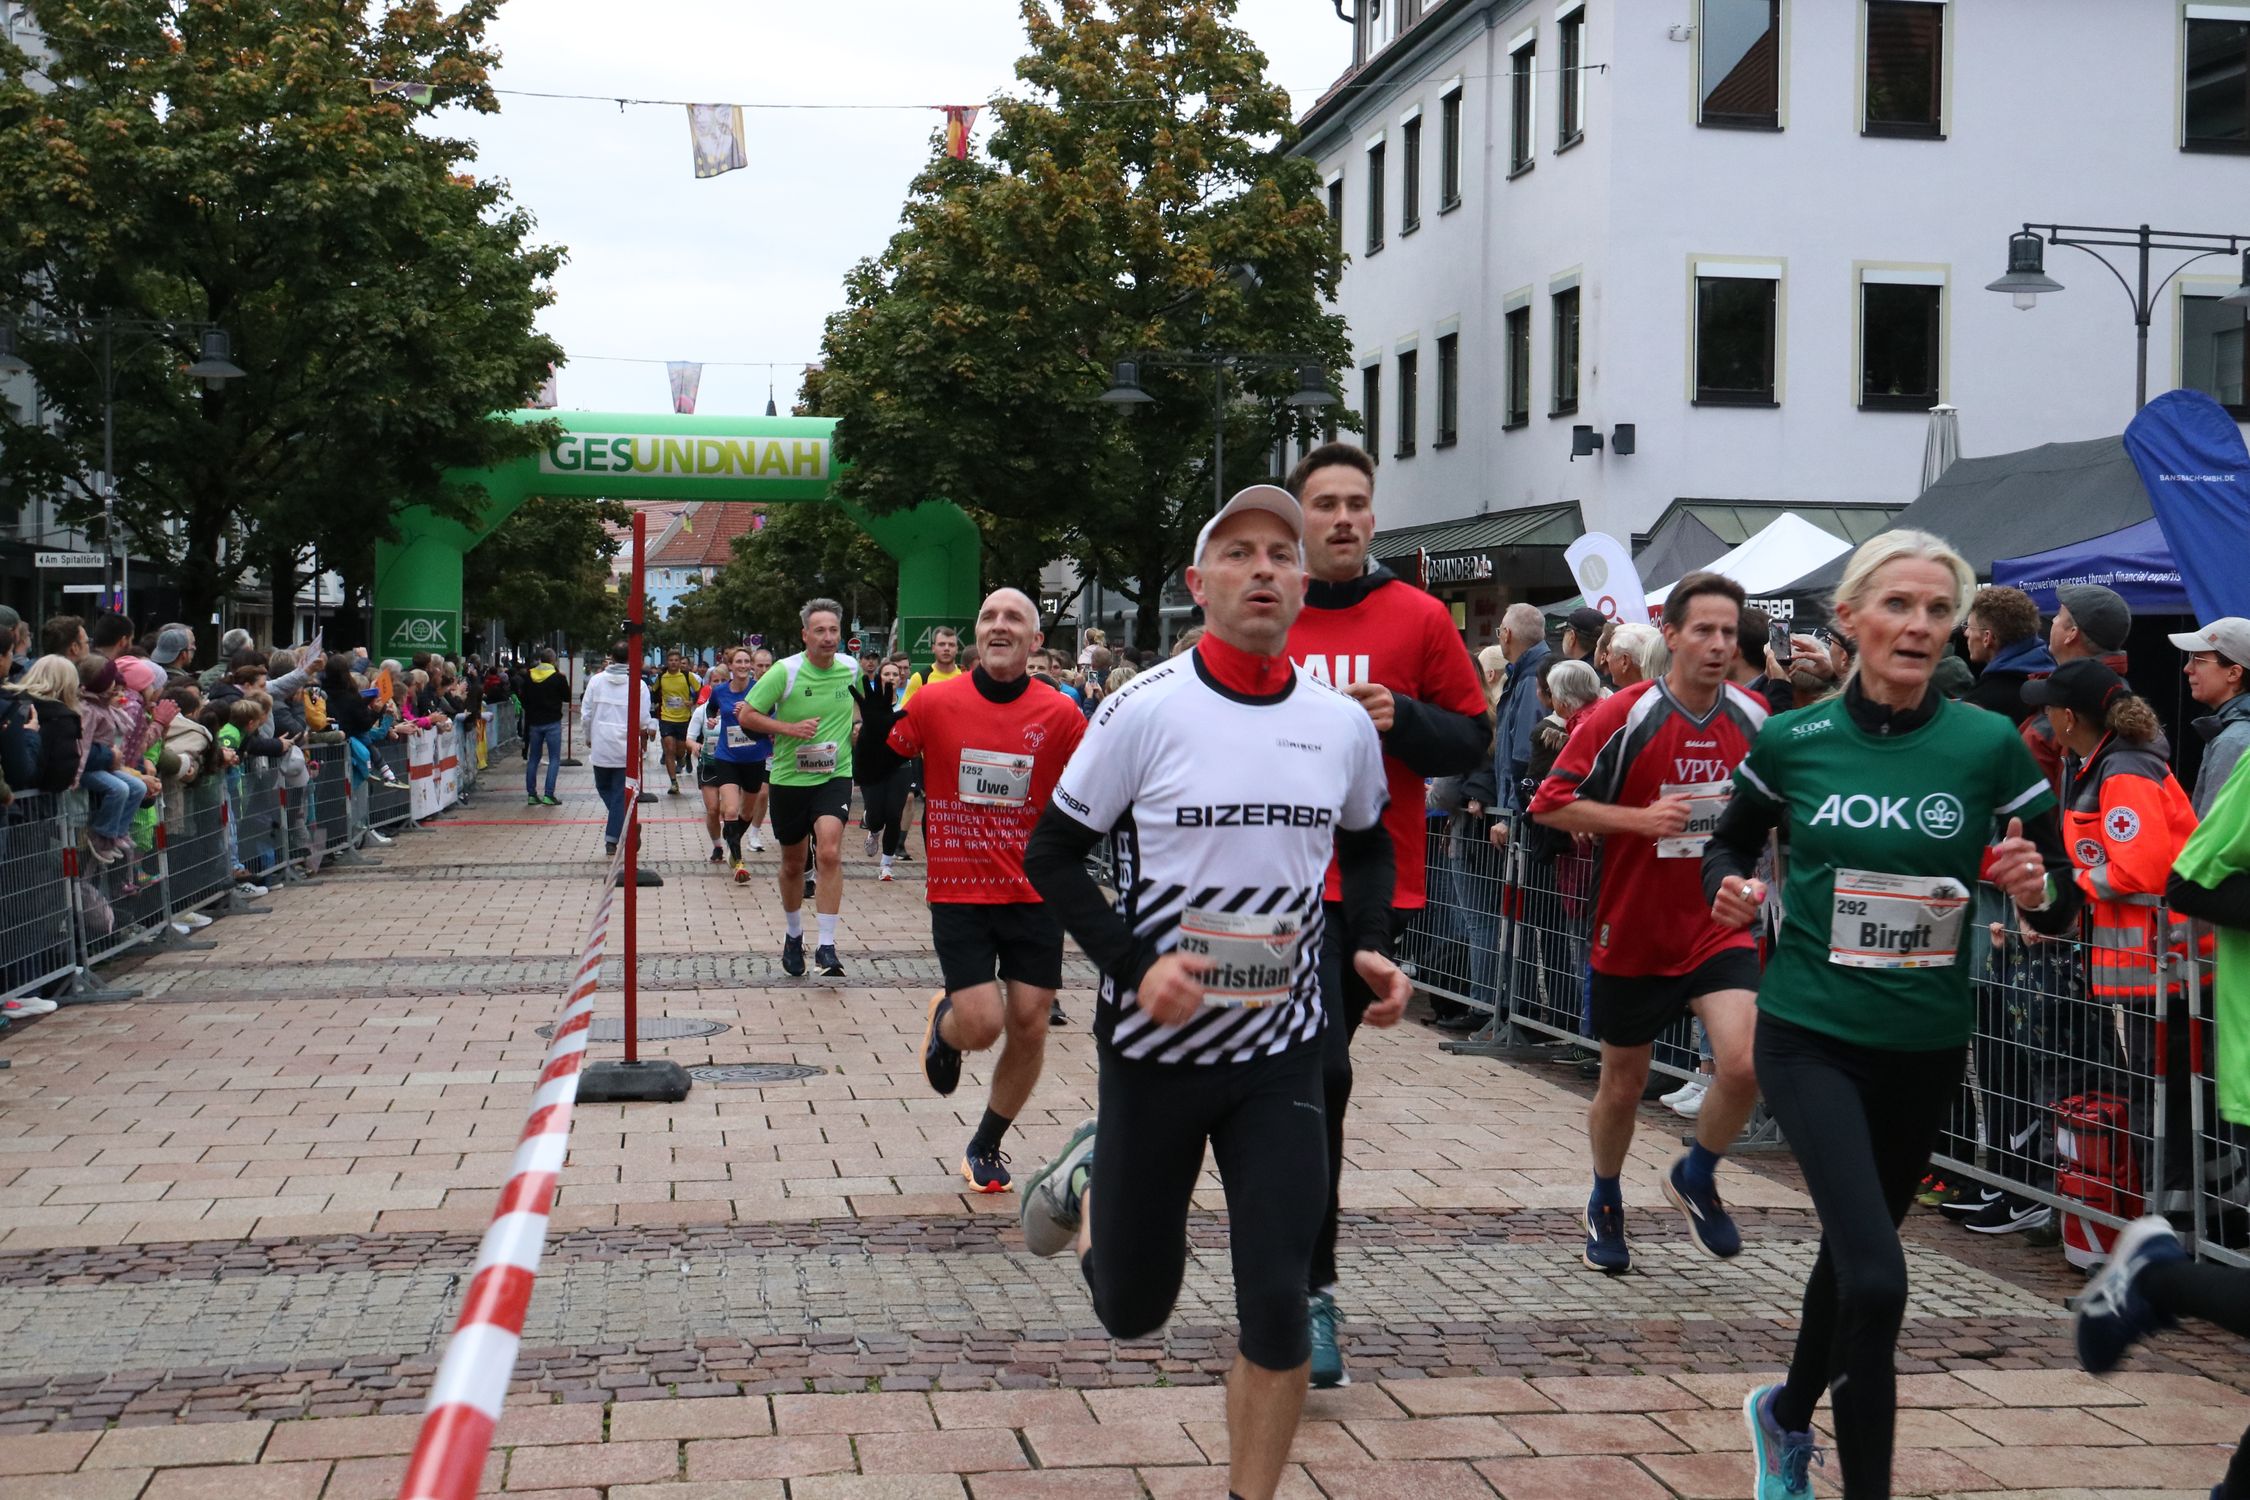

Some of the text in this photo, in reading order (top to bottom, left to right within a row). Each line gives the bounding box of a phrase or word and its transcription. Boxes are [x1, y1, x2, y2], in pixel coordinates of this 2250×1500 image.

[550, 436, 821, 476] GESUNDNAH
[45, 555, 101, 566] Am Spitaltörle
[2019, 578, 2059, 593] Empowering
[2088, 572, 2114, 585] through
[2115, 570, 2148, 583] financial
[2147, 570, 2182, 583] expertis
[391, 619, 447, 642] AOK
[800, 759, 834, 768] Markus
[961, 765, 983, 776] 1252
[976, 779, 1009, 796] Uwe
[929, 800, 949, 810] THE
[1808, 794, 1912, 830] AOK
[928, 812, 985, 825] CONFIDENT
[1176, 803, 1333, 829] BIZERBA
[1683, 814, 1720, 833] eni
[930, 825, 937, 835] A
[943, 826, 981, 837] SINGLE
[1837, 899, 1868, 916] 292
[1180, 936, 1209, 953] 475
[1860, 921, 1932, 955] Birgit
[1190, 962, 1290, 989] hristian
